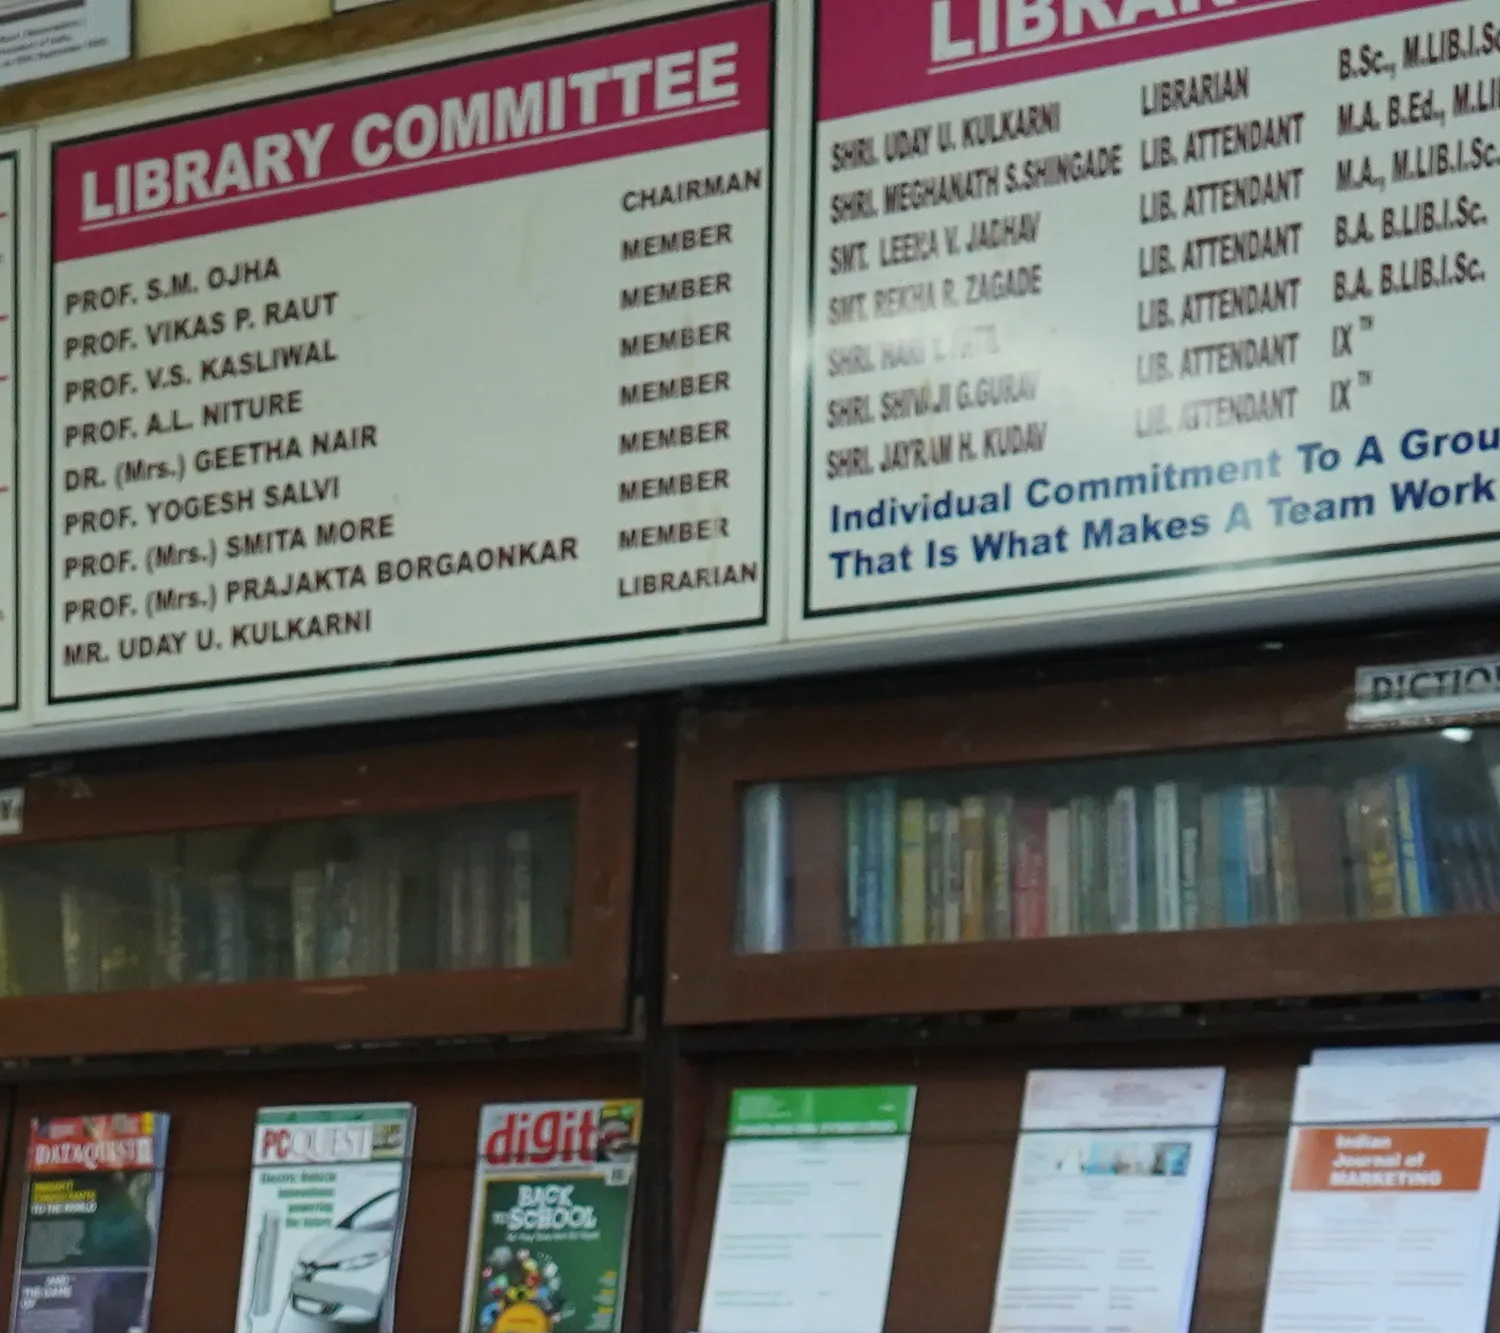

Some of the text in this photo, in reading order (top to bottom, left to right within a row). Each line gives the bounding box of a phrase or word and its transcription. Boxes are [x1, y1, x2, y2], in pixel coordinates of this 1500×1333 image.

[931, 0, 1246, 61] LIBR
[1141, 66, 1250, 116] LIBRARIAN
[81, 40, 739, 222] LIBRARY COMMITTEE
[961, 102, 1060, 147] KULKARNI
[1141, 112, 1306, 171] LIB. ATTENDANT
[620, 168, 762, 212] CHAIRMAN
[1140, 168, 1305, 224] LIB. ATTENDANT
[621, 222, 733, 261] MEMBER
[1138, 222, 1303, 278] LIB. ATTENDANT
[65, 256, 281, 316] PROF. S.M. OJHA
[620, 271, 732, 311] MEMBER
[1137, 277, 1302, 332] LIB. ATTENDANT
[64, 292, 340, 360] PROF. VIKAS P. RAUT
[619, 320, 732, 358] MEMBER
[64, 338, 338, 404] PROF. V.S. KASLIWAL
[1179, 332, 1301, 380] ATTENDANT
[618, 370, 731, 407] MEMBER
[64, 390, 304, 447] PROF. A.L. NITURE
[618, 419, 731, 455] MEMBER
[64, 424, 378, 491] DR. (Mrs.) GEETHA NAIR
[830, 481, 1012, 534] Individual
[1027, 449, 1282, 508] Commitment
[1298, 443, 1340, 474] To
[1356, 435, 1383, 467] A
[64, 476, 341, 535] PROF. YOGESH SALVI
[617, 468, 730, 503] MEMBER
[64, 514, 395, 579] PROF. (Mrs.) SMITA MORE
[617, 517, 730, 551] MEMBER
[830, 472, 1497, 579] That Is What Makes A Team Work
[64, 536, 579, 623] PROF. (Mrs.) PRAJAKTA BORGAONKAR
[617, 562, 758, 599] LIBRARIAN
[62, 608, 372, 666] MR. UDAY U. KULKARNI
[486, 1109, 597, 1166] digit
[1333, 1152, 1426, 1168] Journal of
[1335, 1134, 1393, 1149] Indian
[518, 1184, 576, 1208] BACK
[1329, 1170, 1442, 1187] MARKETING
[508, 1202, 600, 1231] SCHOOL
